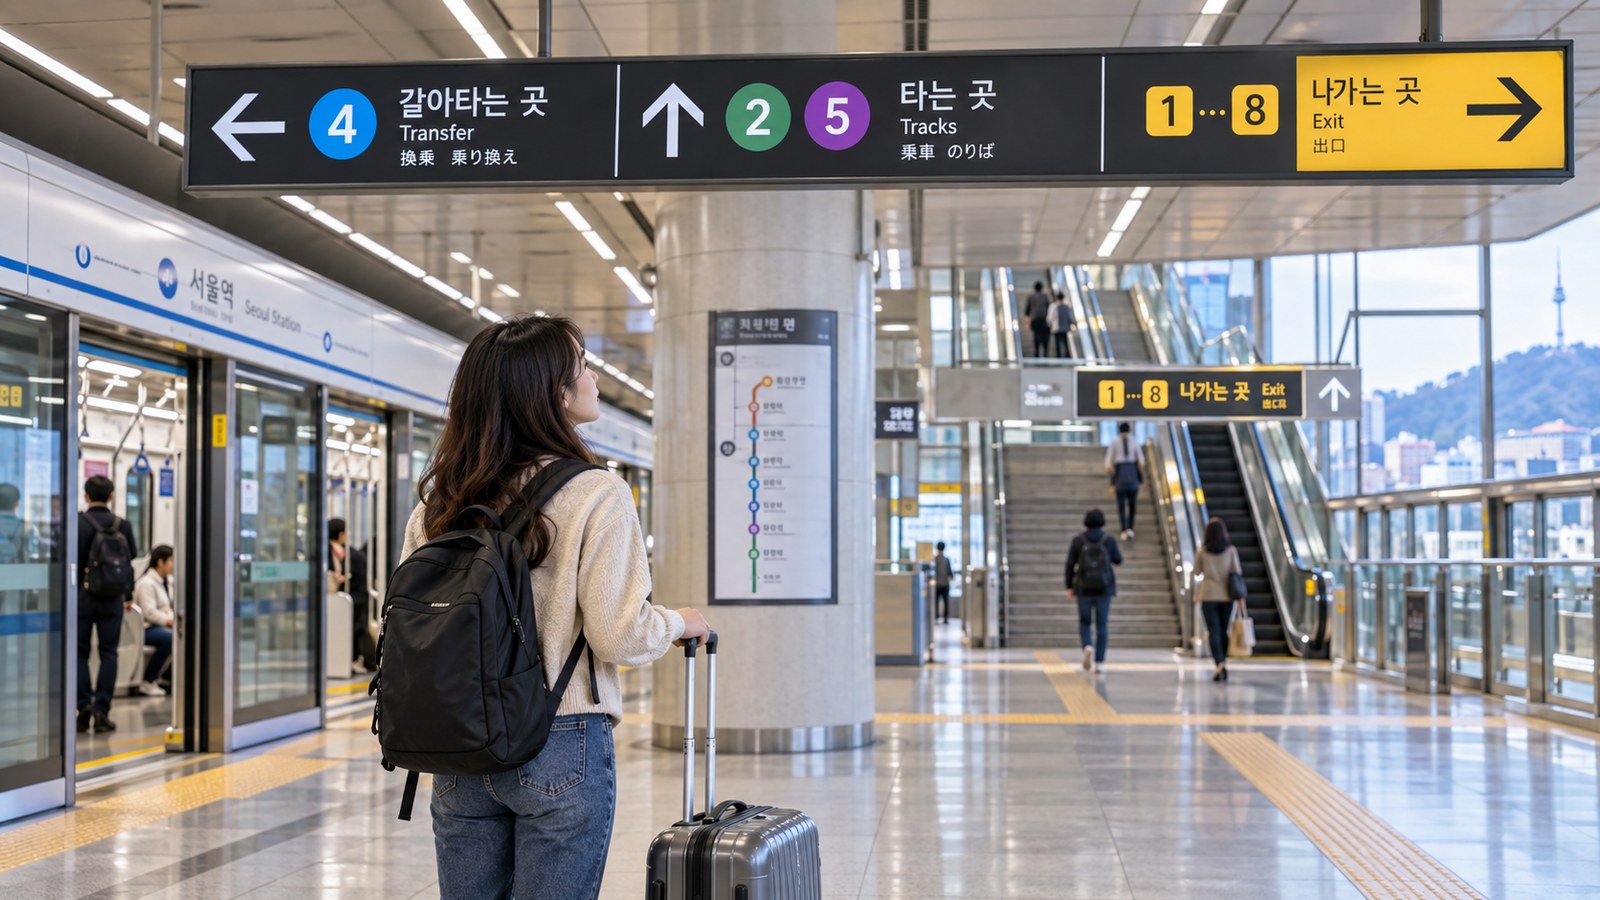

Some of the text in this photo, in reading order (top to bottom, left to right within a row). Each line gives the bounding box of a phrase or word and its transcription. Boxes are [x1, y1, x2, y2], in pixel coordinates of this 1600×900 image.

[399, 86, 548, 118] 갈아타는 곳
[900, 80, 997, 112] 타는 곳
[1312, 77, 1422, 106] 나가는 곳
[745, 98, 771, 136] 2
[825, 97, 850, 135] 5
[1244, 93, 1266, 126] 8
[1313, 113, 1345, 129] Exit
[327, 104, 357, 144] 4
[399, 123, 475, 142] Transfer
[900, 117, 957, 135] Tracks
[400, 148, 518, 167] 換乗 乗り換え
[900, 142, 996, 161] 乗車 のりば
[1313, 137, 1345, 154] 出口
[190, 268, 234, 310] 서울역
[245, 299, 270, 322] Seoul
[271, 310, 302, 334] Station
[1150, 385, 1161, 403] 8
[1179, 381, 1251, 402] 나가는 곳
[1262, 382, 1286, 396] Exit
